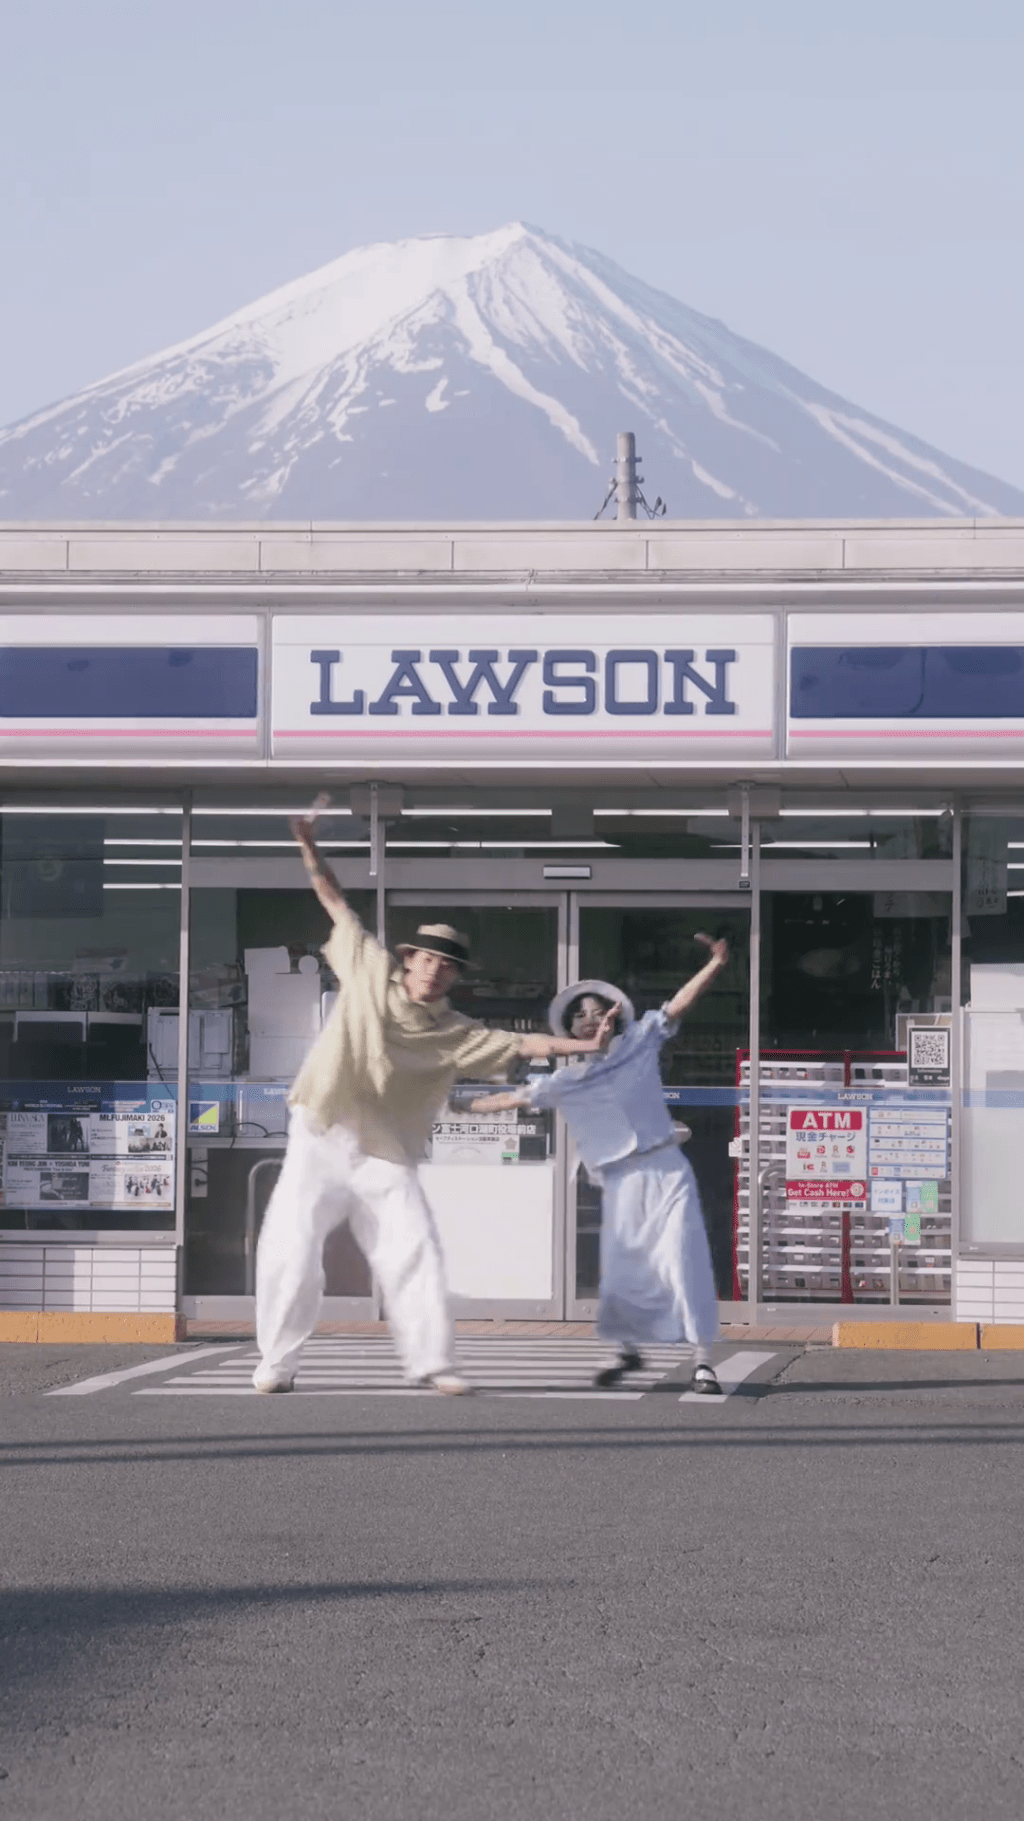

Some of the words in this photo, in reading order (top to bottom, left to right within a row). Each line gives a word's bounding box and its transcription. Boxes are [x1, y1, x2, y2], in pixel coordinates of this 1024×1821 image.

[310, 649, 736, 715] LAWSON
[147, 1114, 165, 1122] 2026
[802, 1112, 851, 1129] ATM
[796, 1131, 856, 1142] 現金チャージ
[788, 1189, 802, 1197] Get
[804, 1188, 824, 1197] Cash
[826, 1188, 850, 1197] Here!
